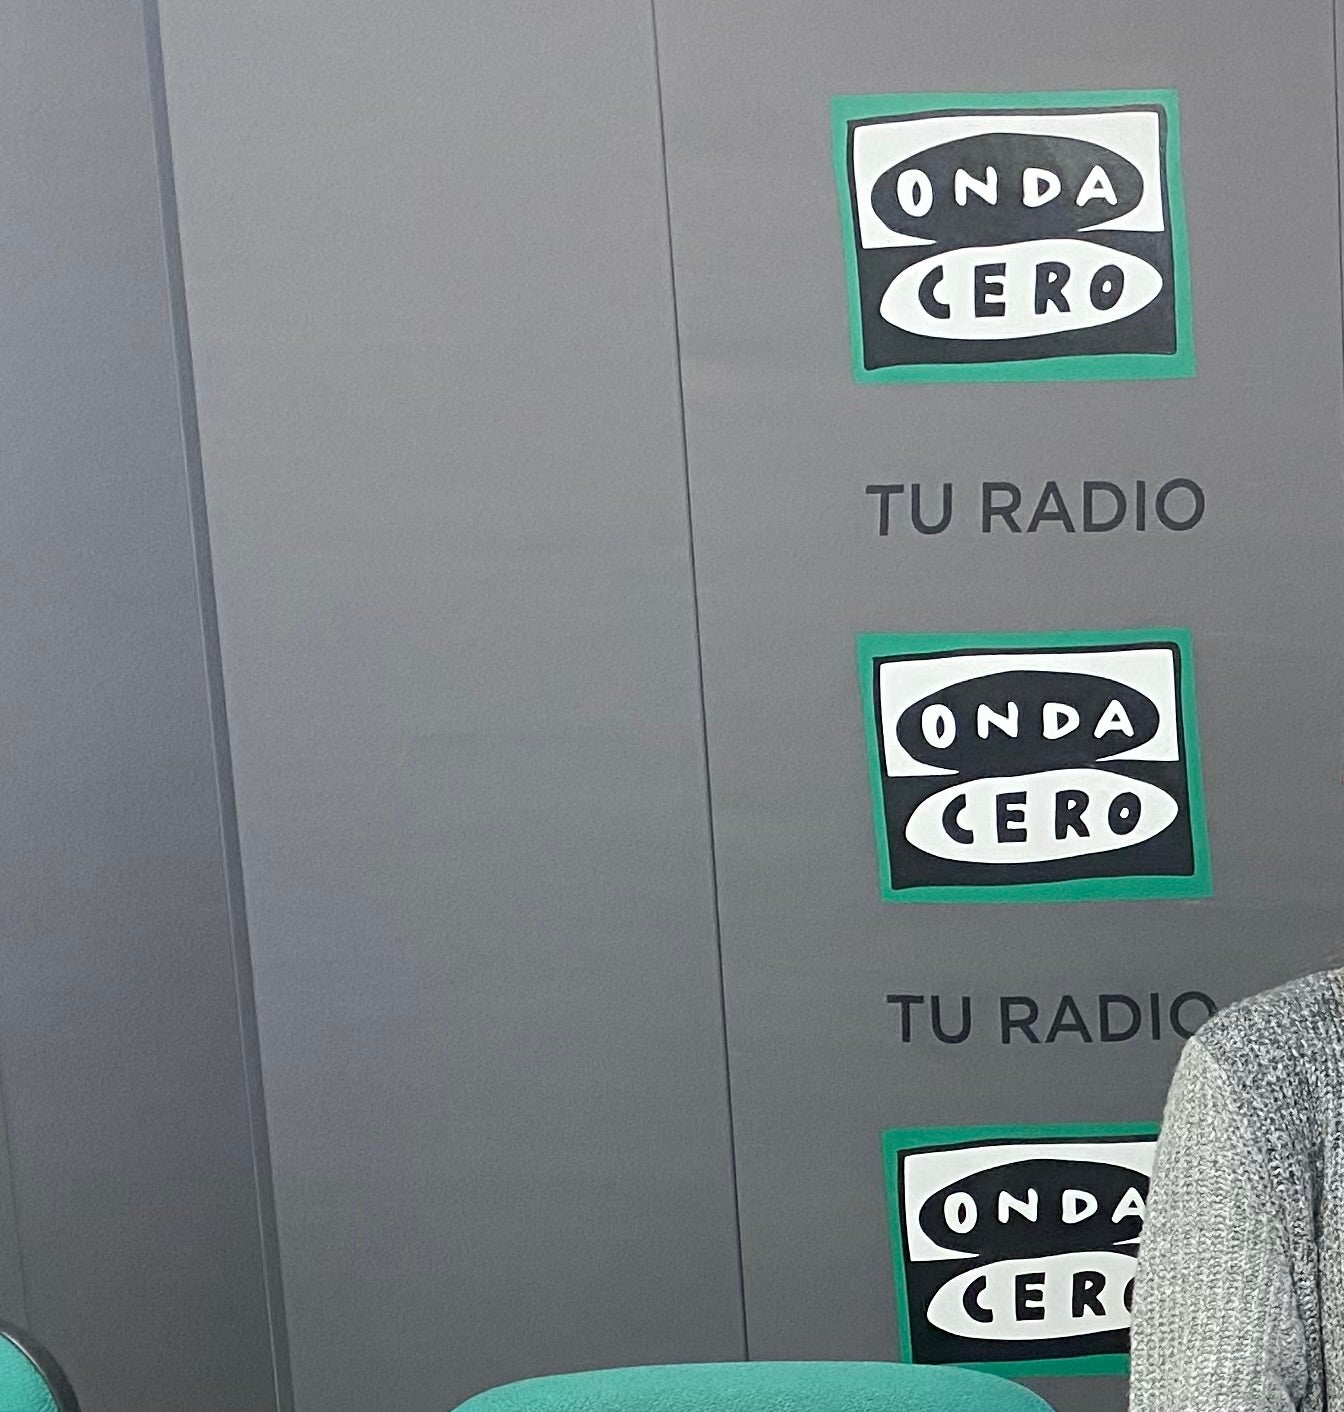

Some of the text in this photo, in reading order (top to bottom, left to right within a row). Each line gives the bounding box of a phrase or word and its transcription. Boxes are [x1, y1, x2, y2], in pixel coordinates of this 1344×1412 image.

[896, 165, 1119, 218] ONDA
[917, 261, 1126, 319] CERO
[865, 478, 1206, 536] TU RADIO
[921, 699, 1135, 749] ONDA
[942, 790, 1143, 845] CERO
[886, 990, 1218, 1044] TU RADIO
[943, 1186, 1147, 1234] ONDA
[962, 1270, 1134, 1324] CER
